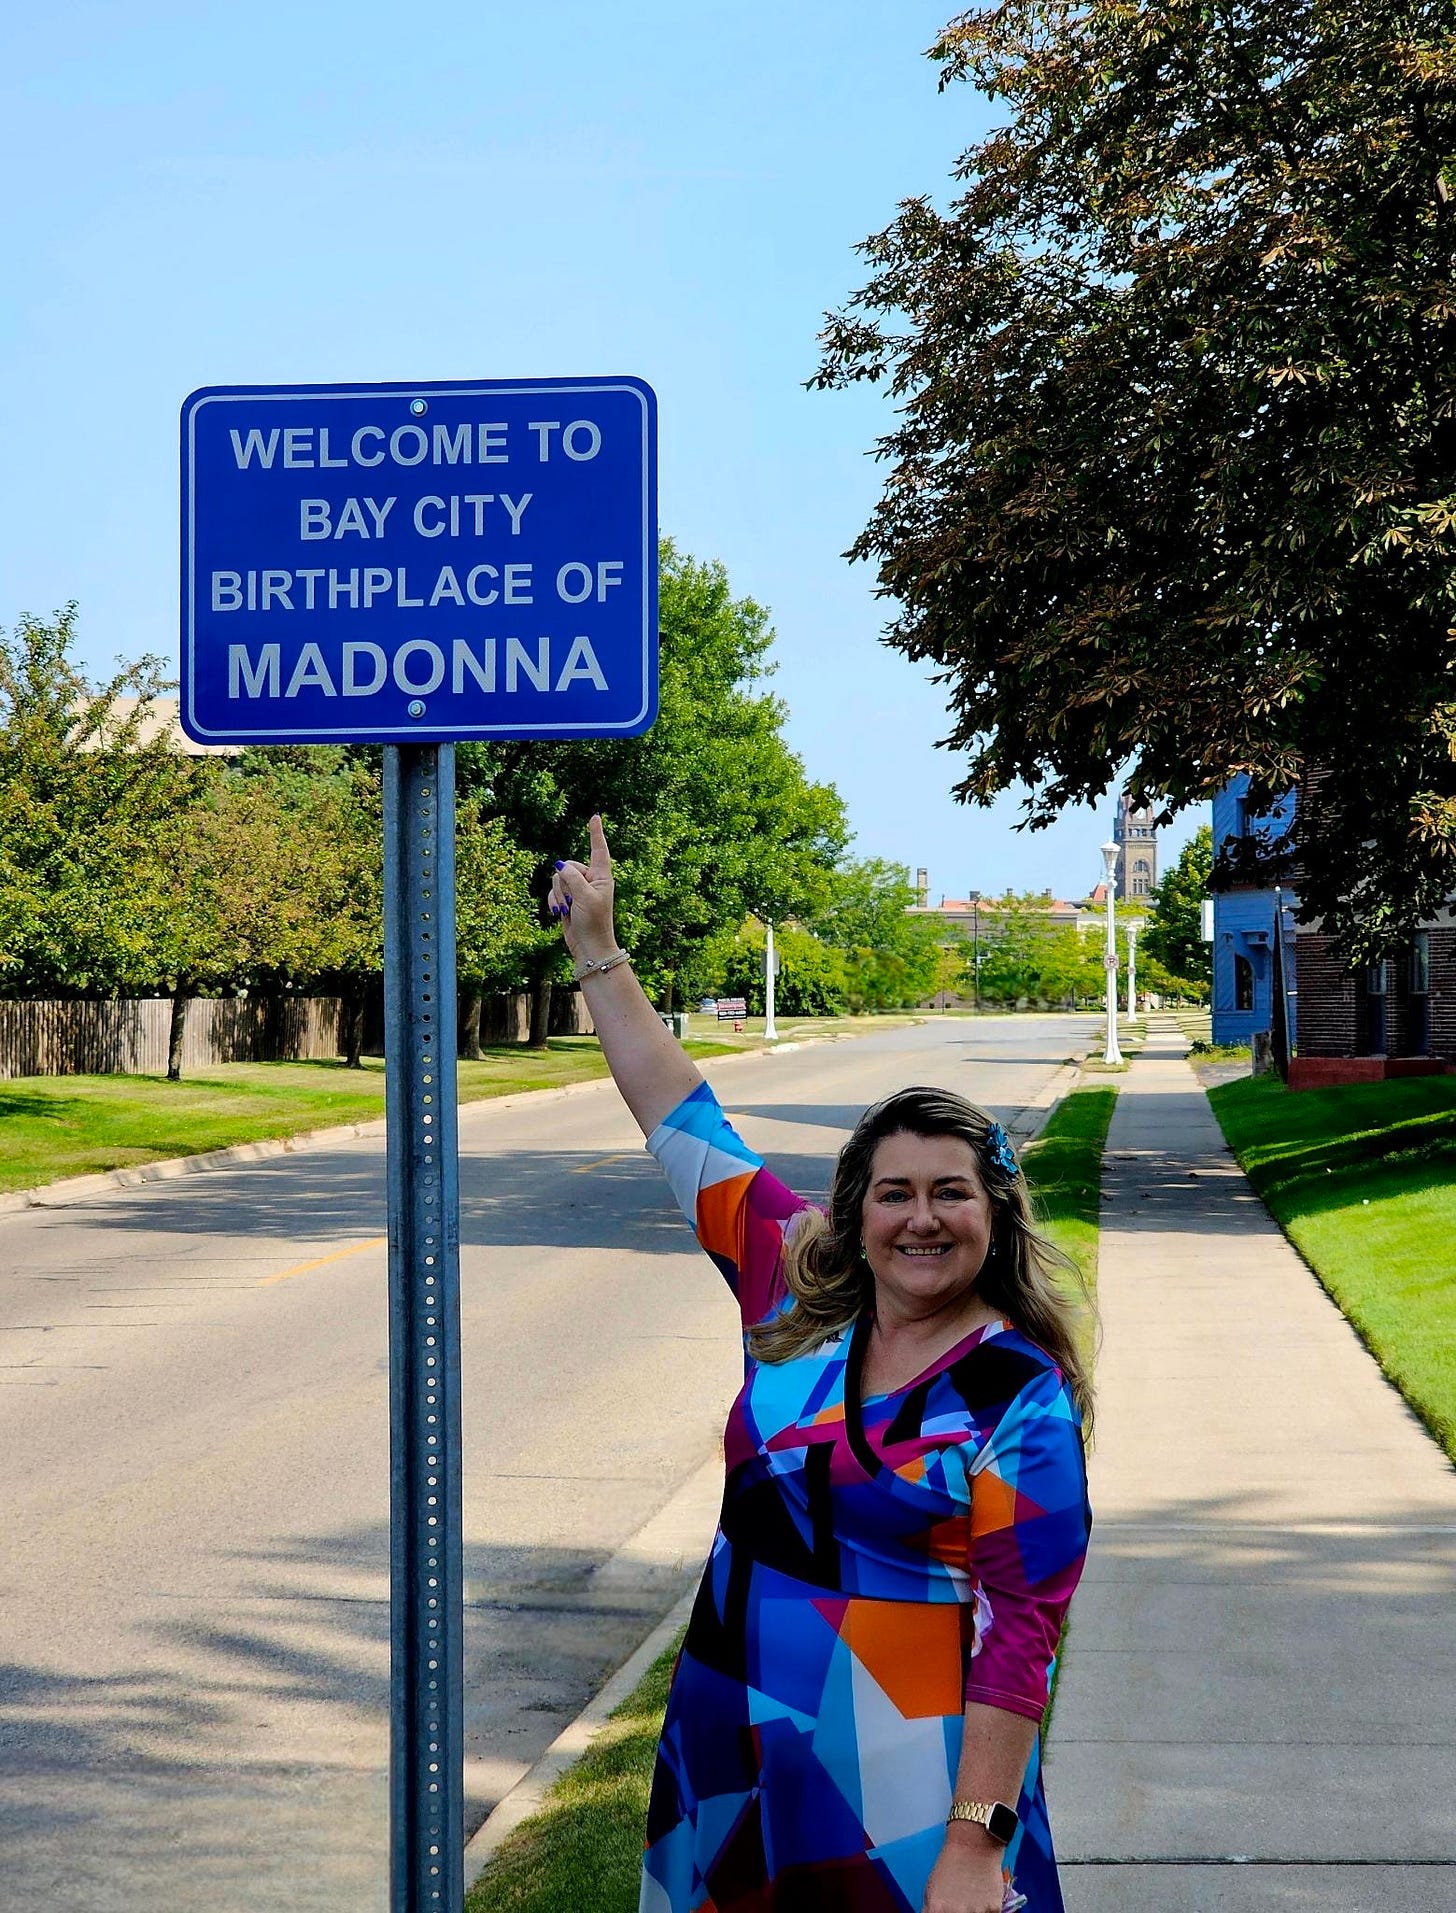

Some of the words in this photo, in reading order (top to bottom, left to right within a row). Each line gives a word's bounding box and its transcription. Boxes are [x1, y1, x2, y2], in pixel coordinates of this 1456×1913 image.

[229, 423, 509, 470] WELCOME
[528, 419, 602, 463] TO
[300, 496, 397, 541] BAY
[413, 493, 534, 538] CITY
[211, 564, 534, 612] BIRTHPLACE
[556, 561, 624, 605] OF
[228, 636, 609, 699] MADONNA
